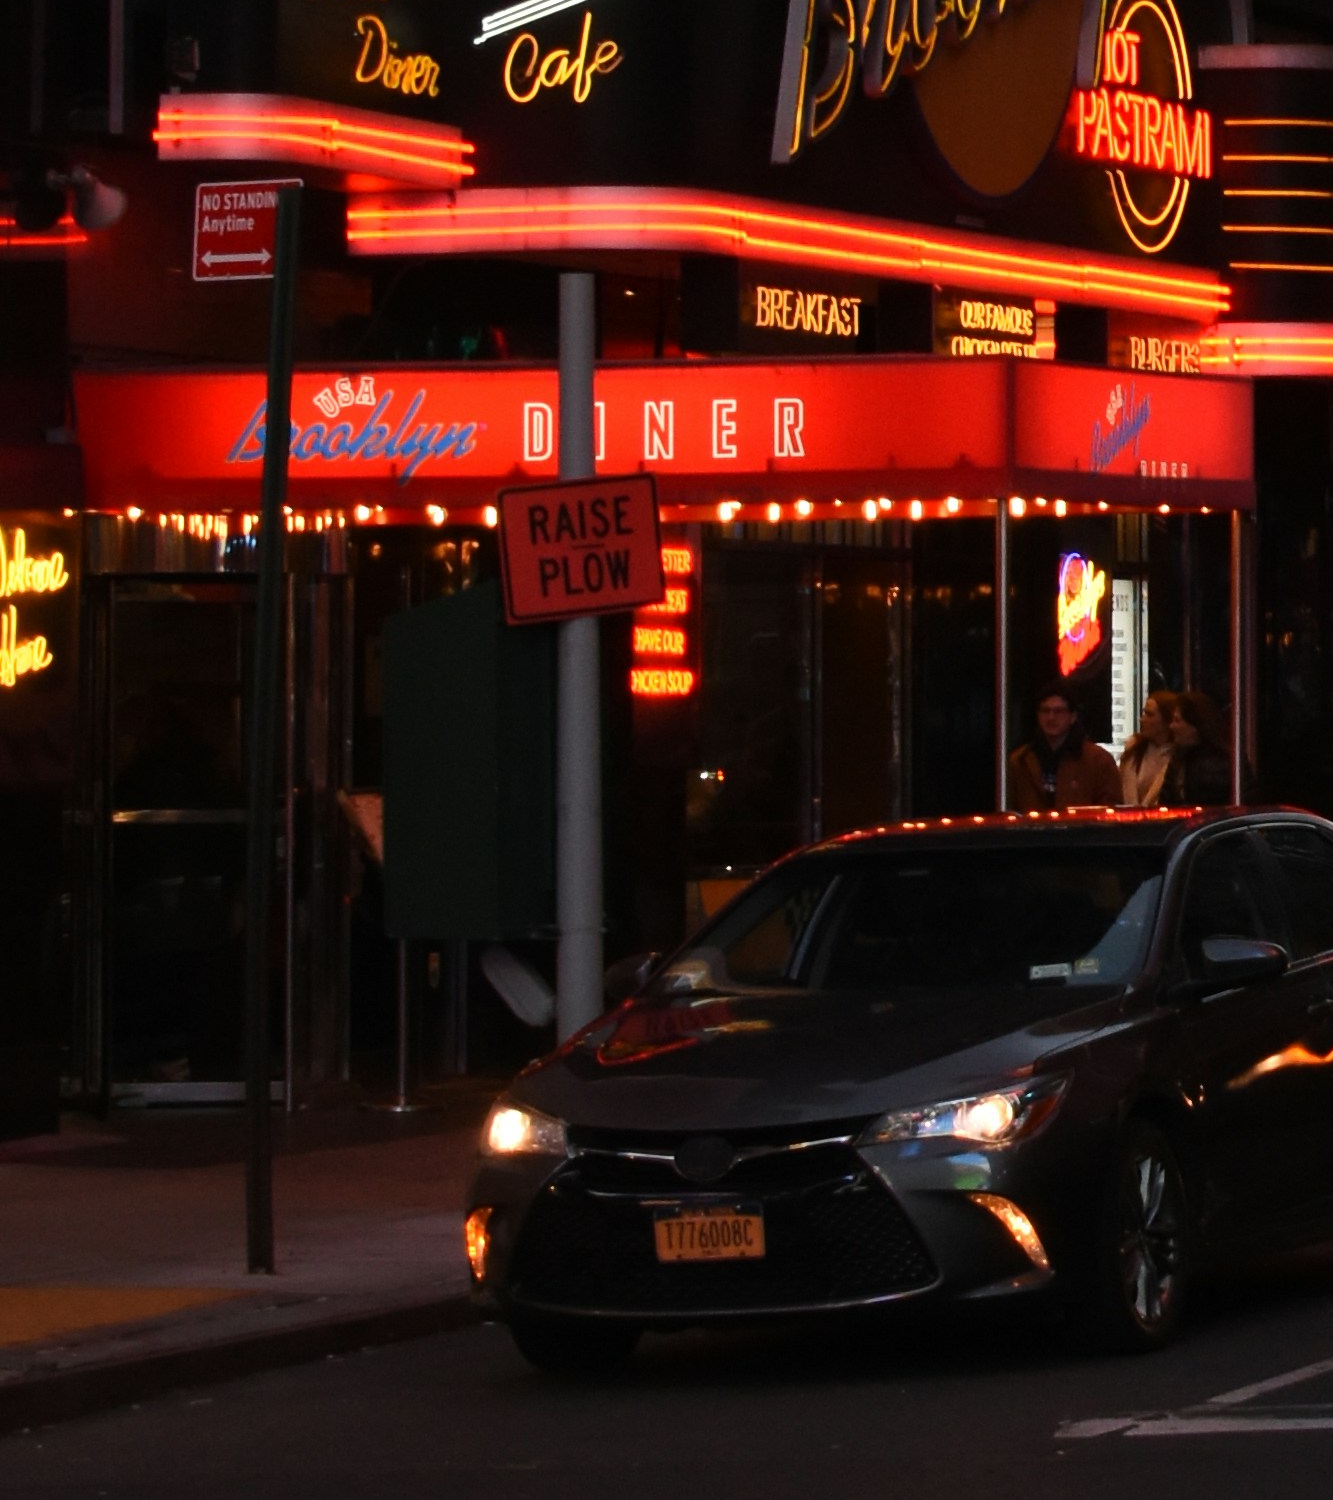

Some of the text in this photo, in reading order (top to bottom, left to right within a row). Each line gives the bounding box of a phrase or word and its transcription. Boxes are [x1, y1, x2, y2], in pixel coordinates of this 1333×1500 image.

[354, 14, 441, 98] Diner
[504, 9, 625, 104] Cafe
[1076, 86, 1212, 179] PASTRAMI
[201, 214, 256, 237] Anytime
[202, 190, 279, 212] NO STANDIN
[755, 286, 861, 336] BREAKFAST
[1129, 335, 1200, 373] BURGERS
[313, 376, 377, 419] USA
[528, 494, 634, 546] RAISE
[538, 550, 631, 599] PLOW
[661, 547, 692, 574] ETTER
